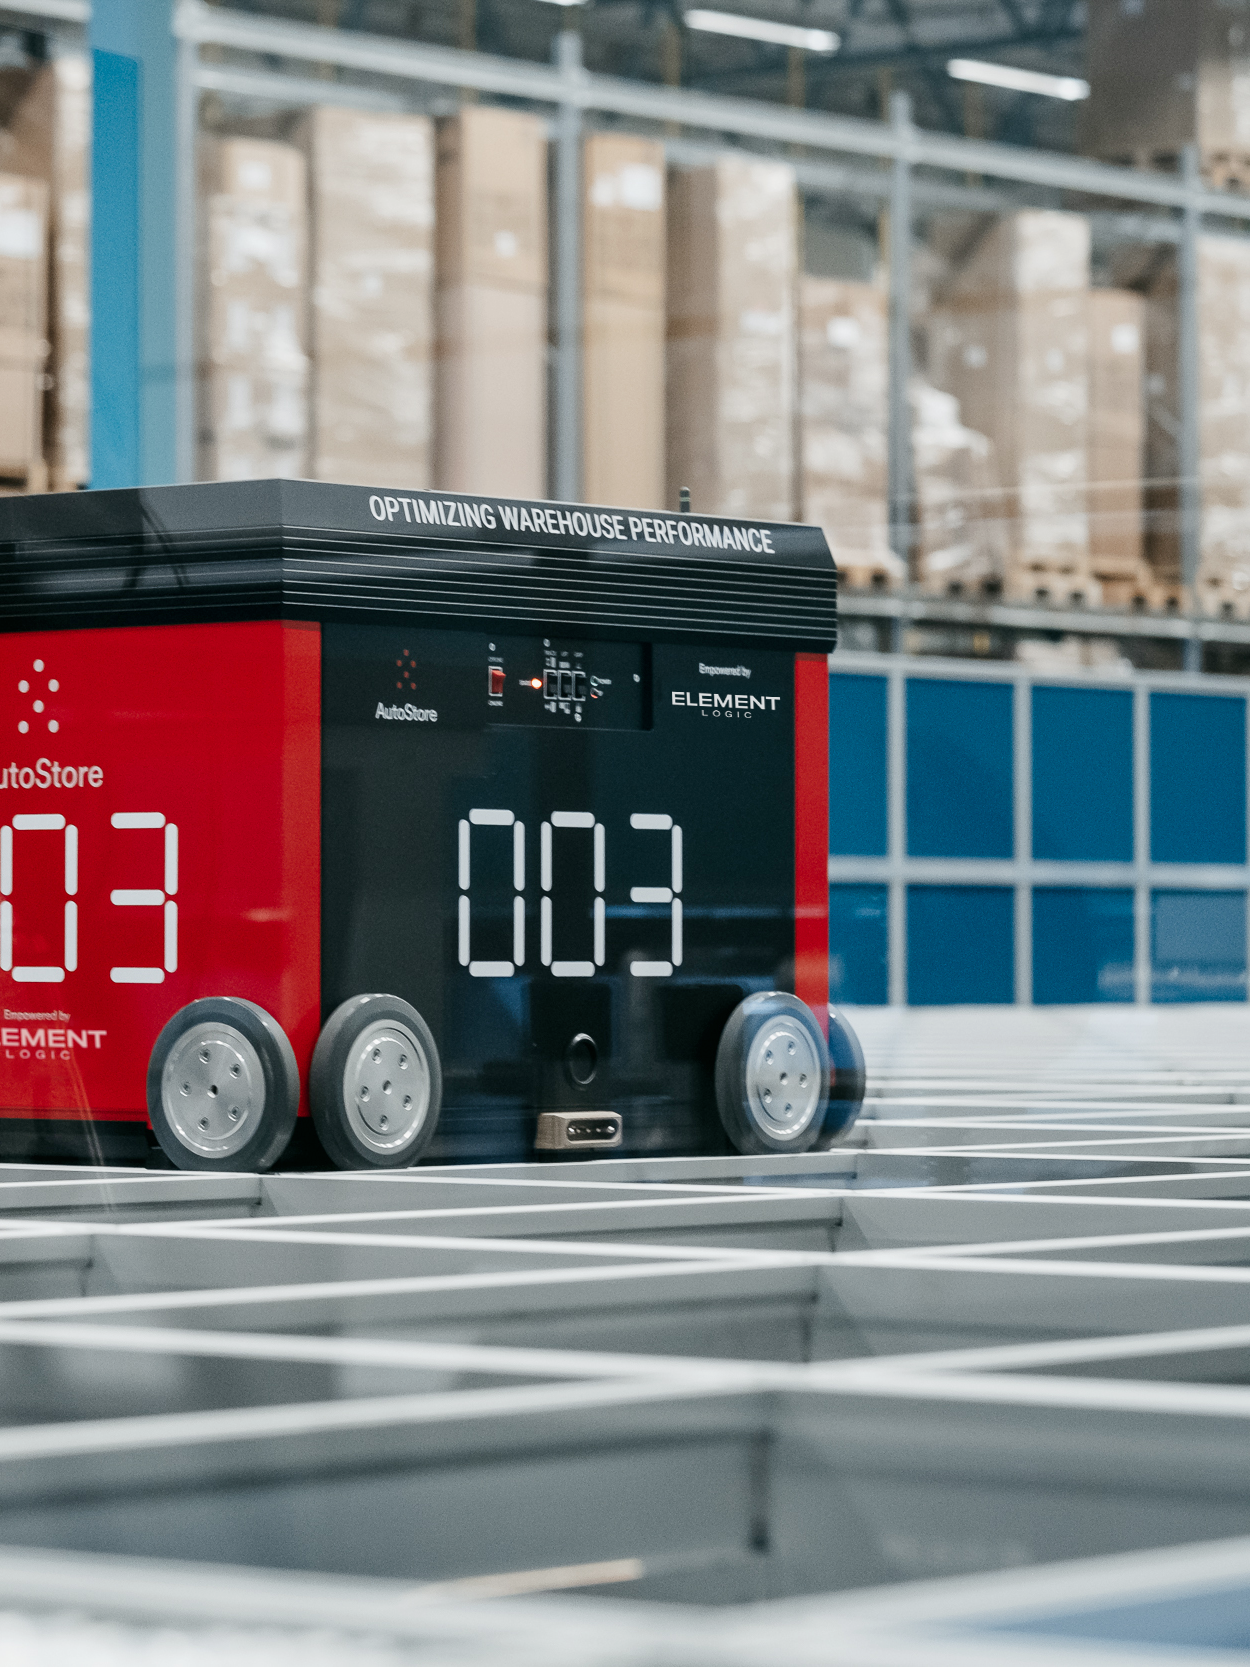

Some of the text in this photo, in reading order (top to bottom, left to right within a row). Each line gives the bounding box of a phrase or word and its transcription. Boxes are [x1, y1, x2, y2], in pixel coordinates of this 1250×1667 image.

[368, 495, 776, 554] OPTIMIZING WAREHOUSE PERFORMANCE
[671, 691, 781, 711] ELEMENT
[375, 702, 438, 722] AutoStore
[701, 709, 752, 719] LOGIC
[458, 808, 684, 977] 003
[3, 1009, 71, 1023] Empowered by
[5, 1049, 71, 1060] LOGIC
